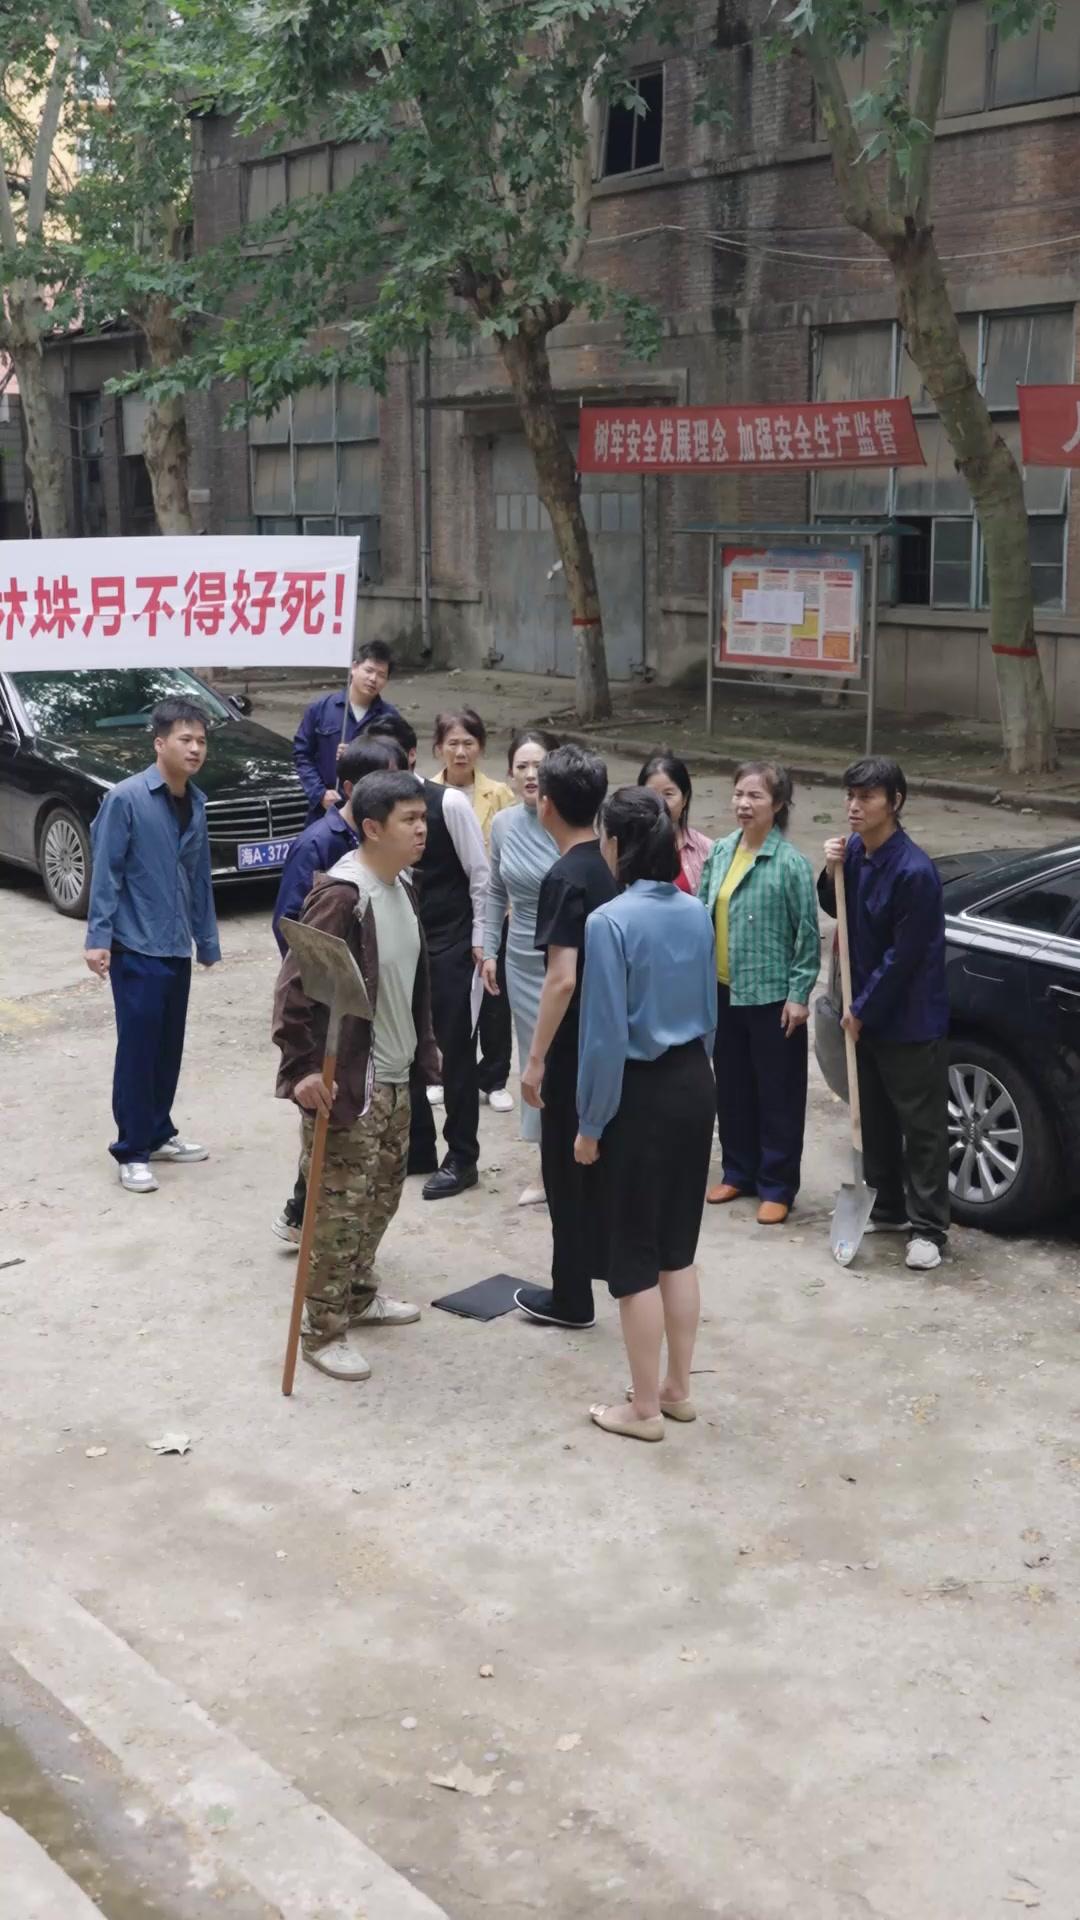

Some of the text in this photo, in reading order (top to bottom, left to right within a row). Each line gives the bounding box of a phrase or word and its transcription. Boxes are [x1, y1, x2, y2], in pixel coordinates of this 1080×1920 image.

[594, 408, 897, 464] 树牢安全发展理念 加强安全生产监管
[241, 842, 293, 865] 海A·372
